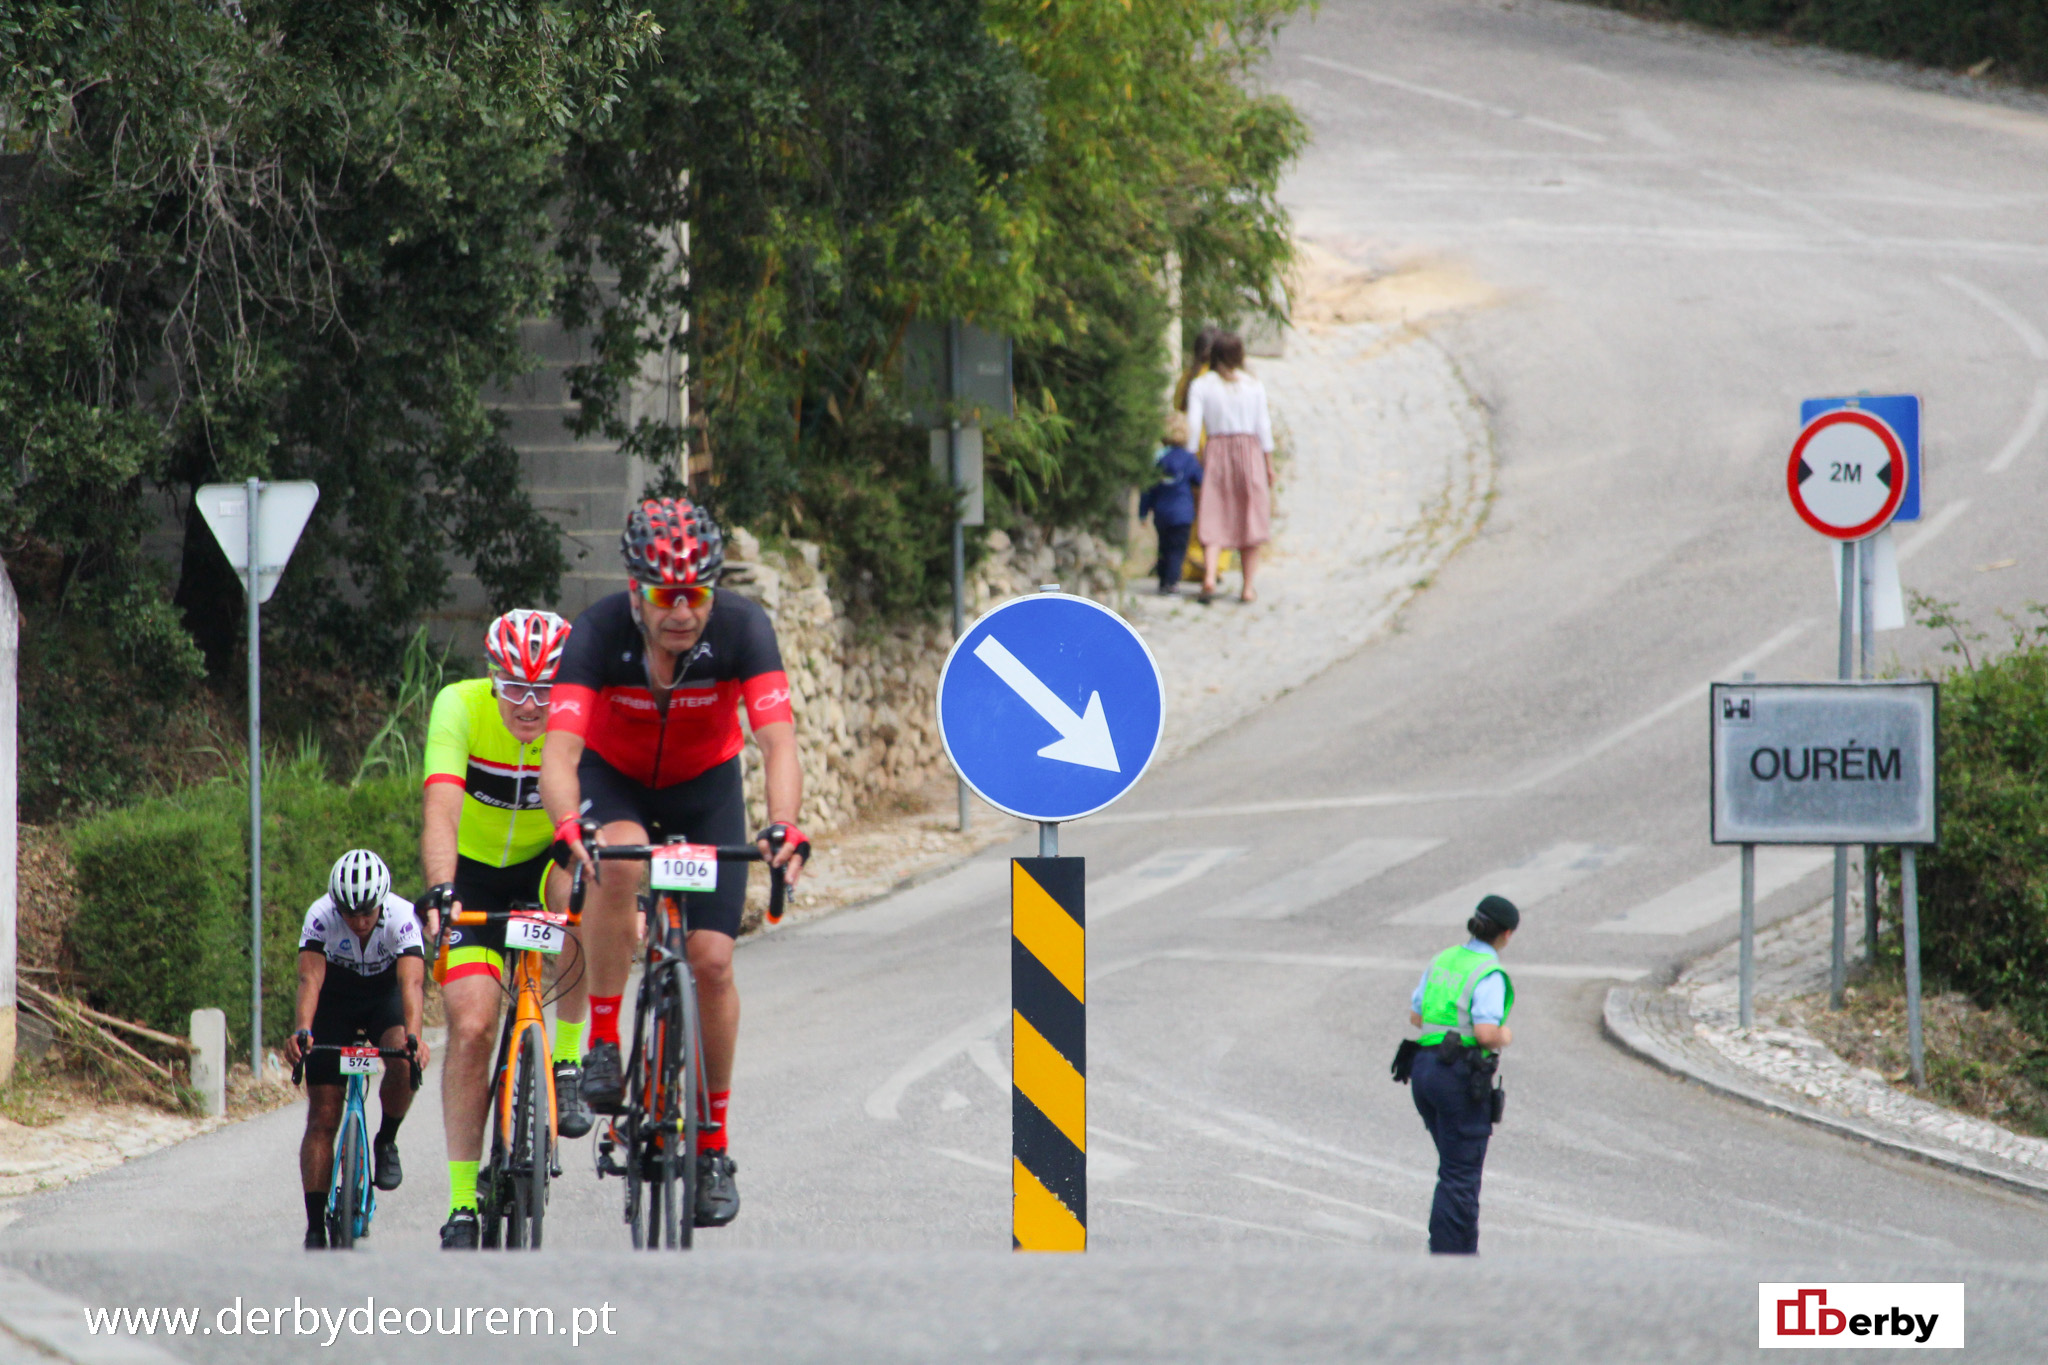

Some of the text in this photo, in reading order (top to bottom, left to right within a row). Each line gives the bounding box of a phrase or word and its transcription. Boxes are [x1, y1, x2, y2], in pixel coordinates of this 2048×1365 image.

[1829, 461, 1862, 483] 2M
[1750, 738, 1901, 782] OURÉM
[663, 860, 708, 877] 1006
[522, 923, 551, 941] 156
[349, 1057, 370, 1068] 574
